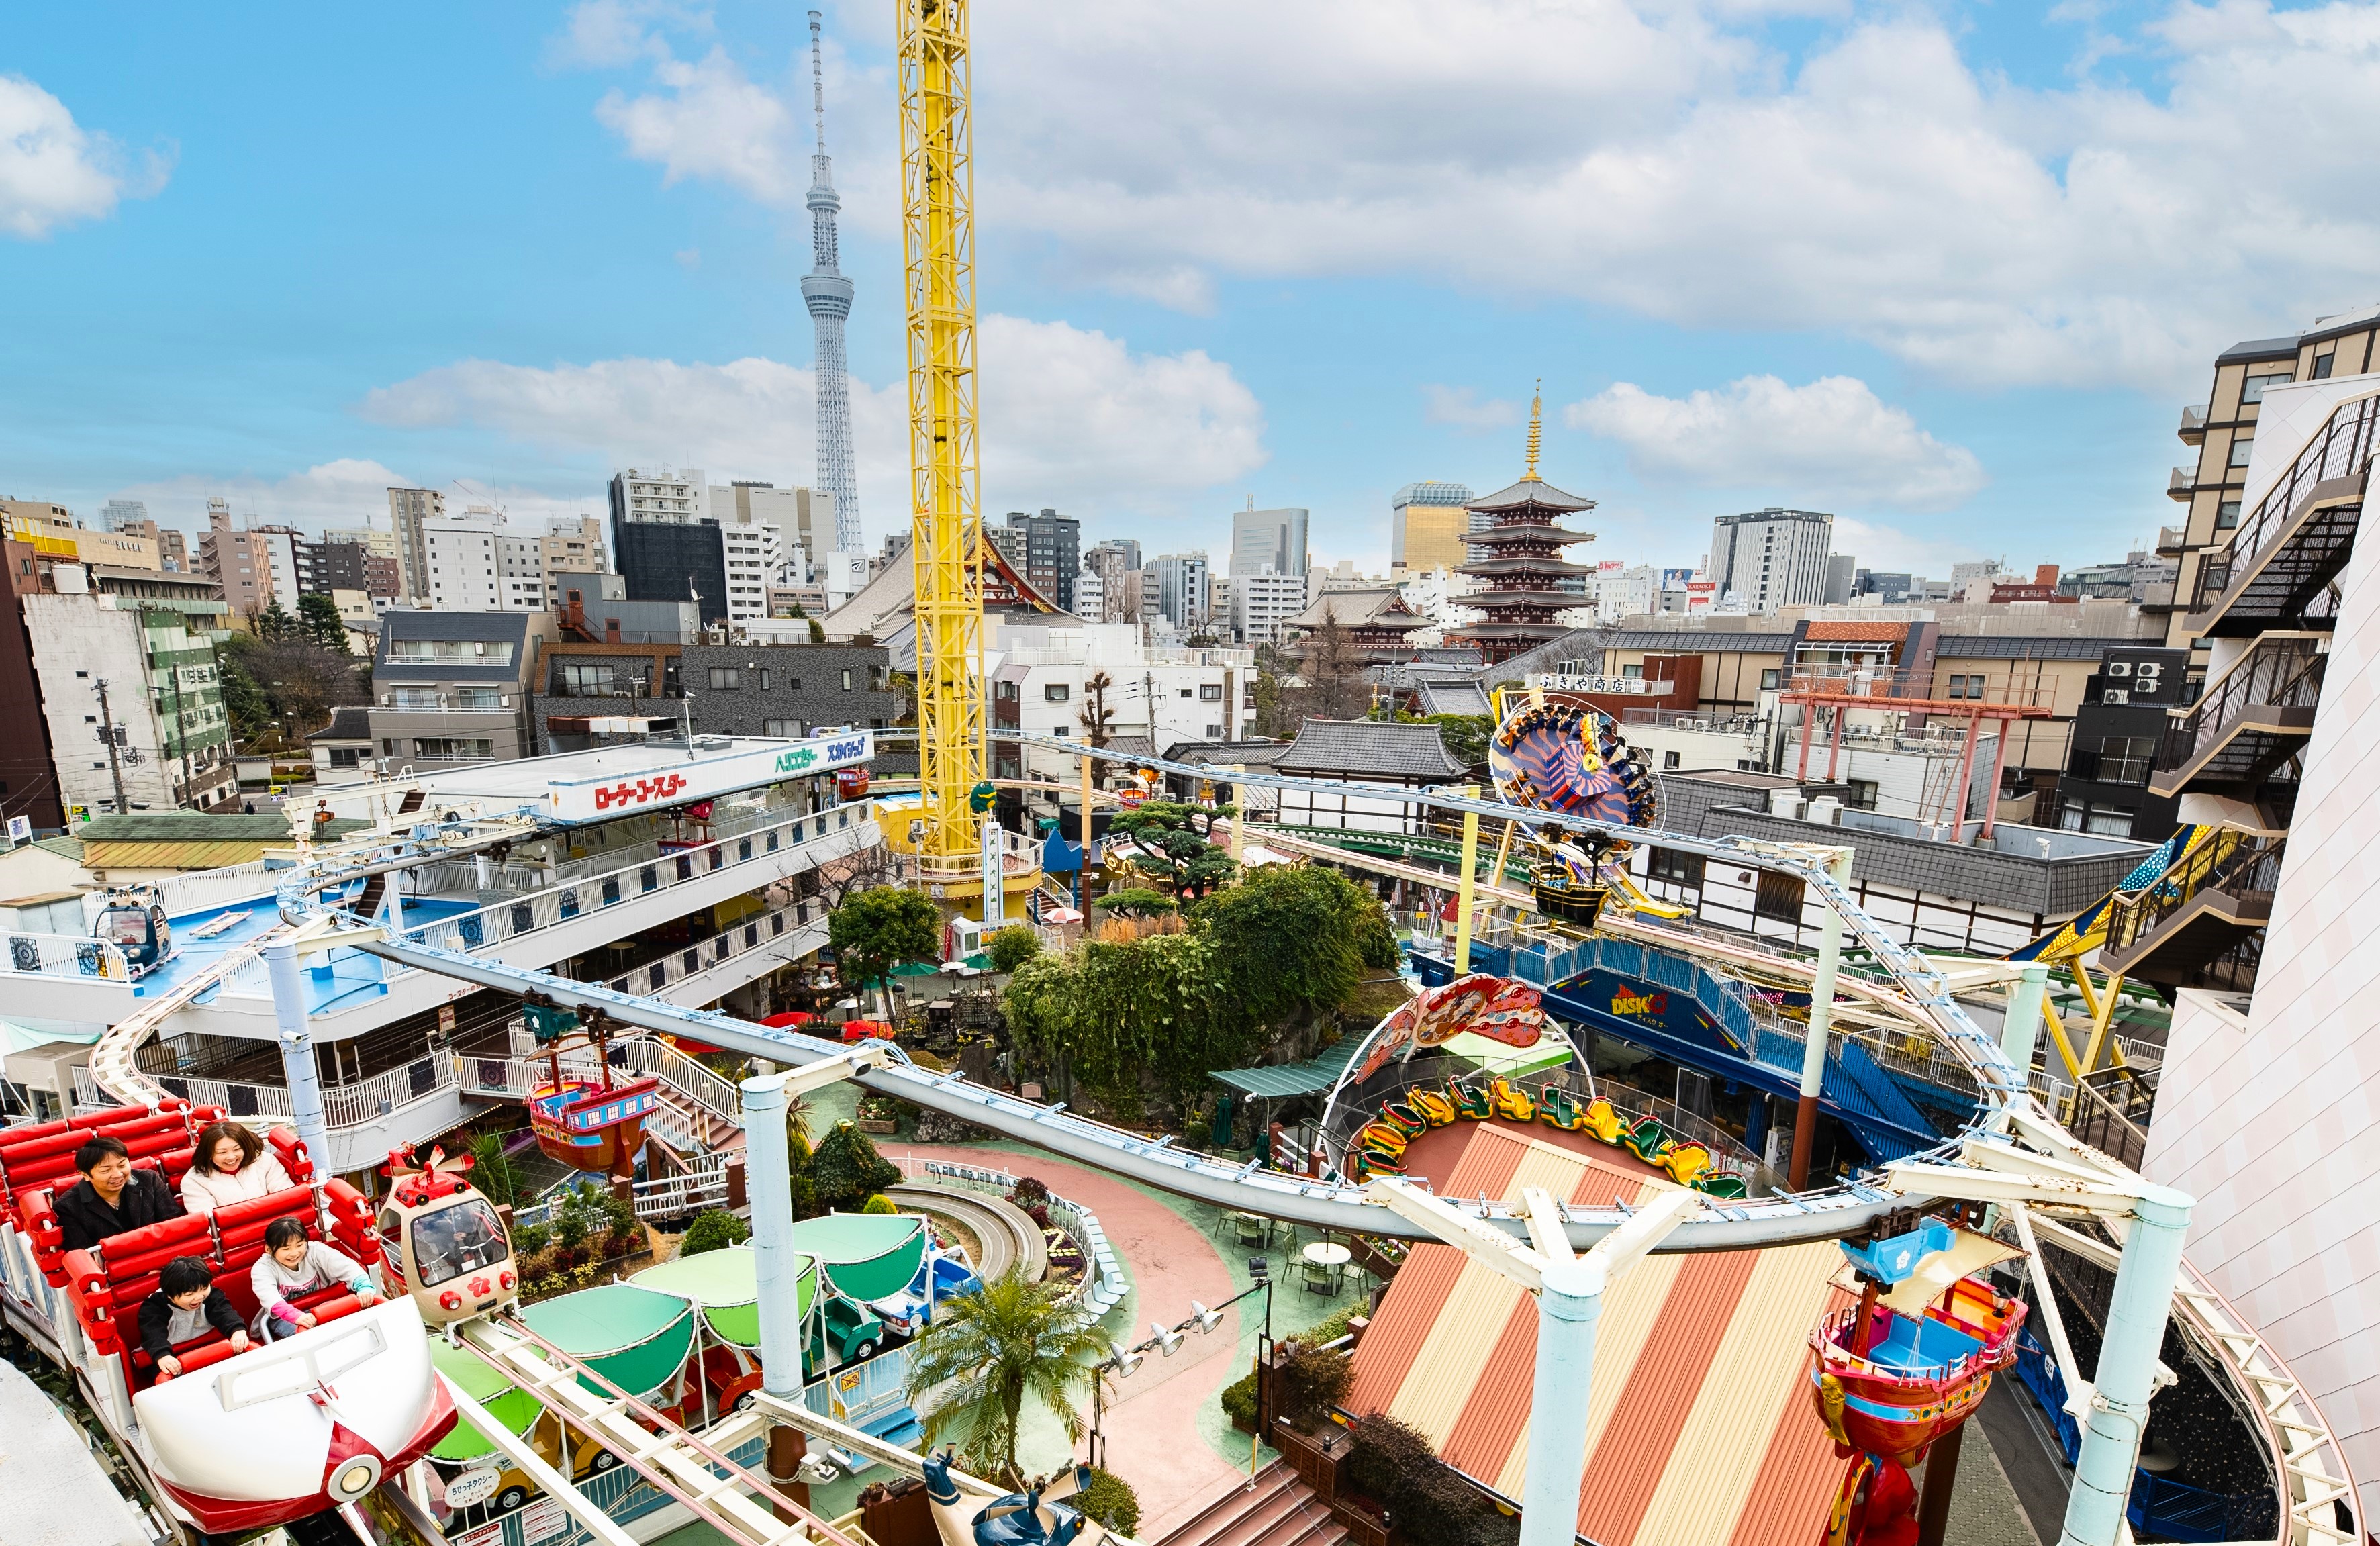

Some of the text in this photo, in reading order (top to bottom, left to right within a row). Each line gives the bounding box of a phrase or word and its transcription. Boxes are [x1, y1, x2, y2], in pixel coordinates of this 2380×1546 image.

[1540, 675, 1623, 691] ふきや商店
[775, 748, 818, 773] ヘリコプター
[827, 736, 865, 763] スカイシップ
[595, 773, 687, 810] ローラーコースター
[474, 1281, 483, 1292] 7
[452, 1476, 493, 1496] ちびっ子タクシー
